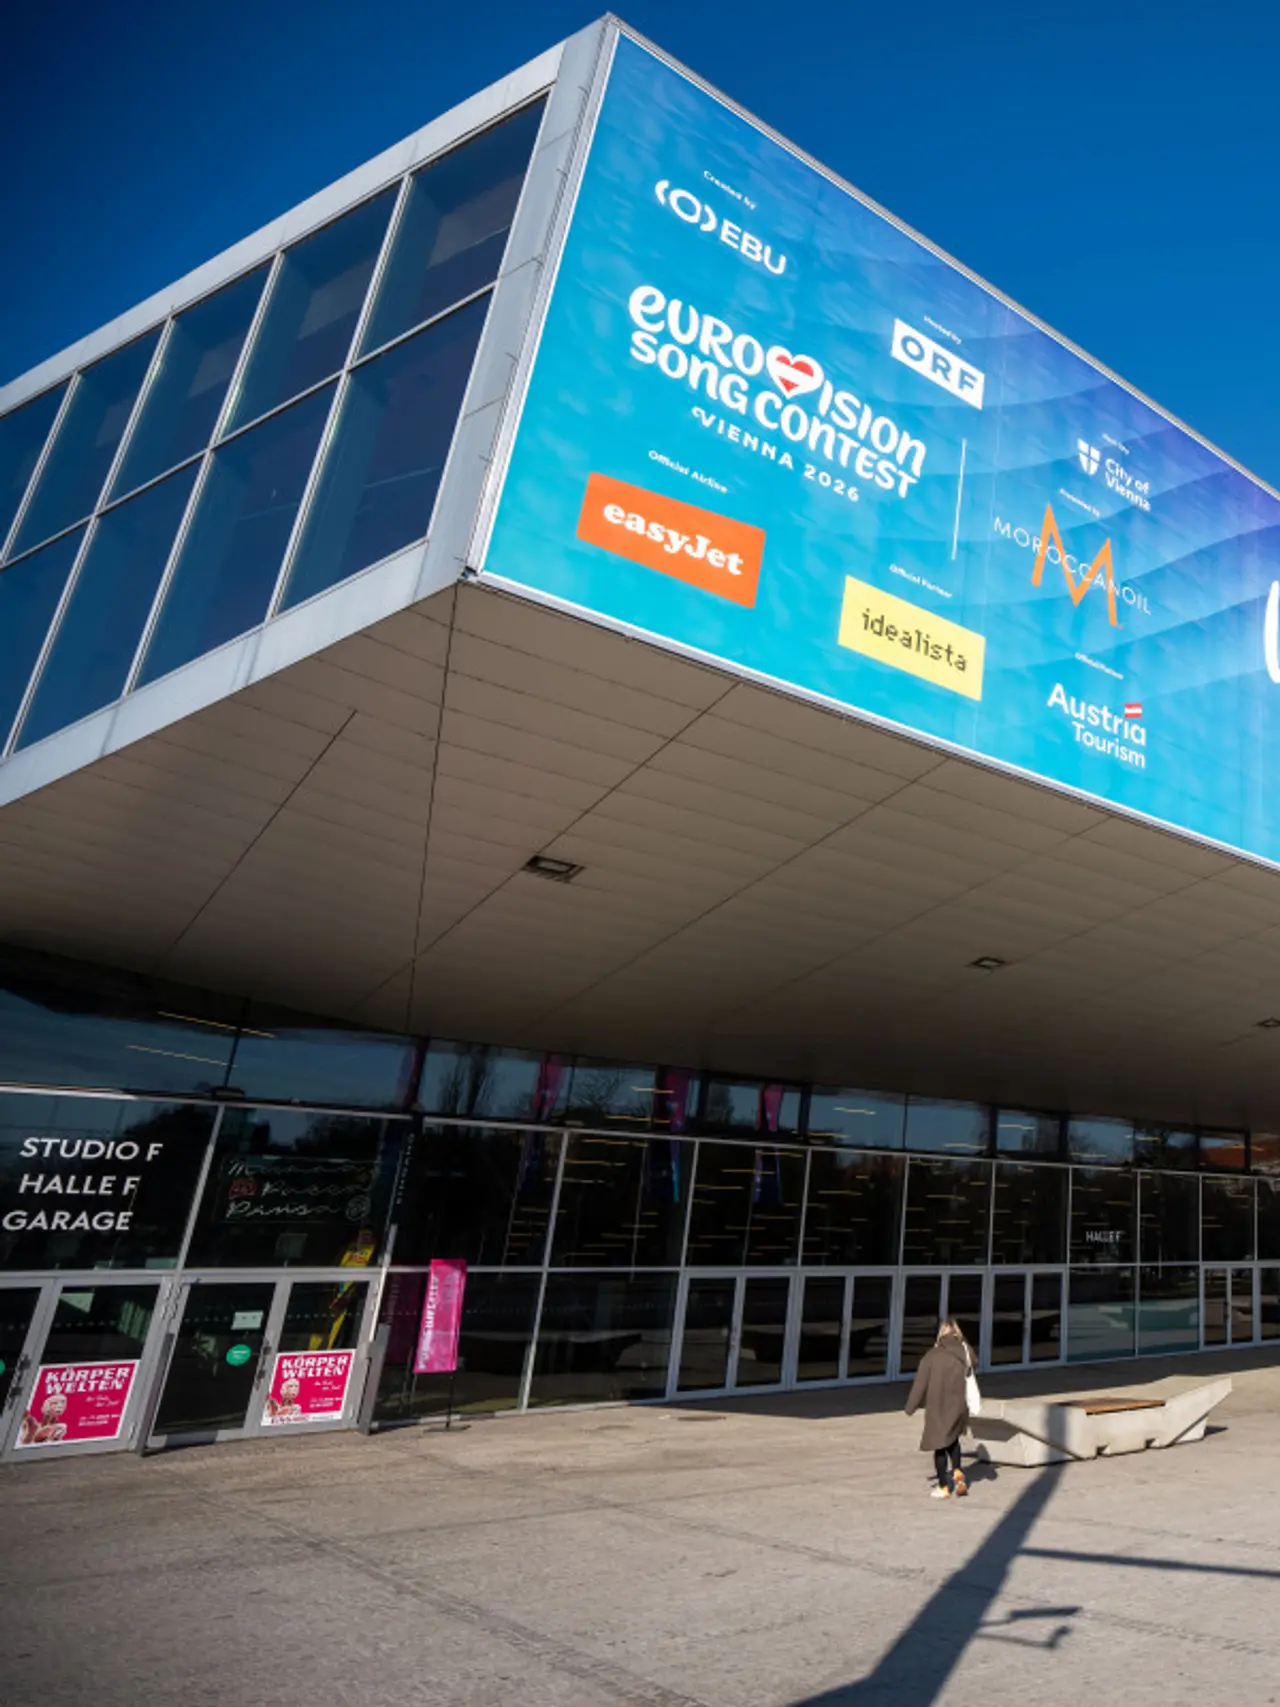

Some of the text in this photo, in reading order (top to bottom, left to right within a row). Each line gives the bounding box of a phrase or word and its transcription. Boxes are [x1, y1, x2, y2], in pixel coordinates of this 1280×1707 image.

[720, 219, 787, 274] EBU
[900, 333, 981, 394] ORF
[692, 407, 860, 502] VIENNA 2026
[1105, 458, 1150, 495] City of
[1105, 471, 1151, 513] Vienna
[603, 504, 743, 576] easyJet
[994, 516, 1151, 615] MOROCCANOIL
[862, 607, 968, 673] idealista
[1047, 683, 1147, 746] Austria
[1072, 721, 1146, 769] Tourism
[19, 1137, 163, 1162] STUDIO F
[18, 1173, 140, 1196] HALLE F
[2, 1210, 133, 1232] GARAGE
[45, 1366, 130, 1384] KÖRPER
[282, 1354, 349, 1369] KÖRPER
[283, 1366, 344, 1379] WELTEN
[45, 1379, 125, 1395] WELTEN
